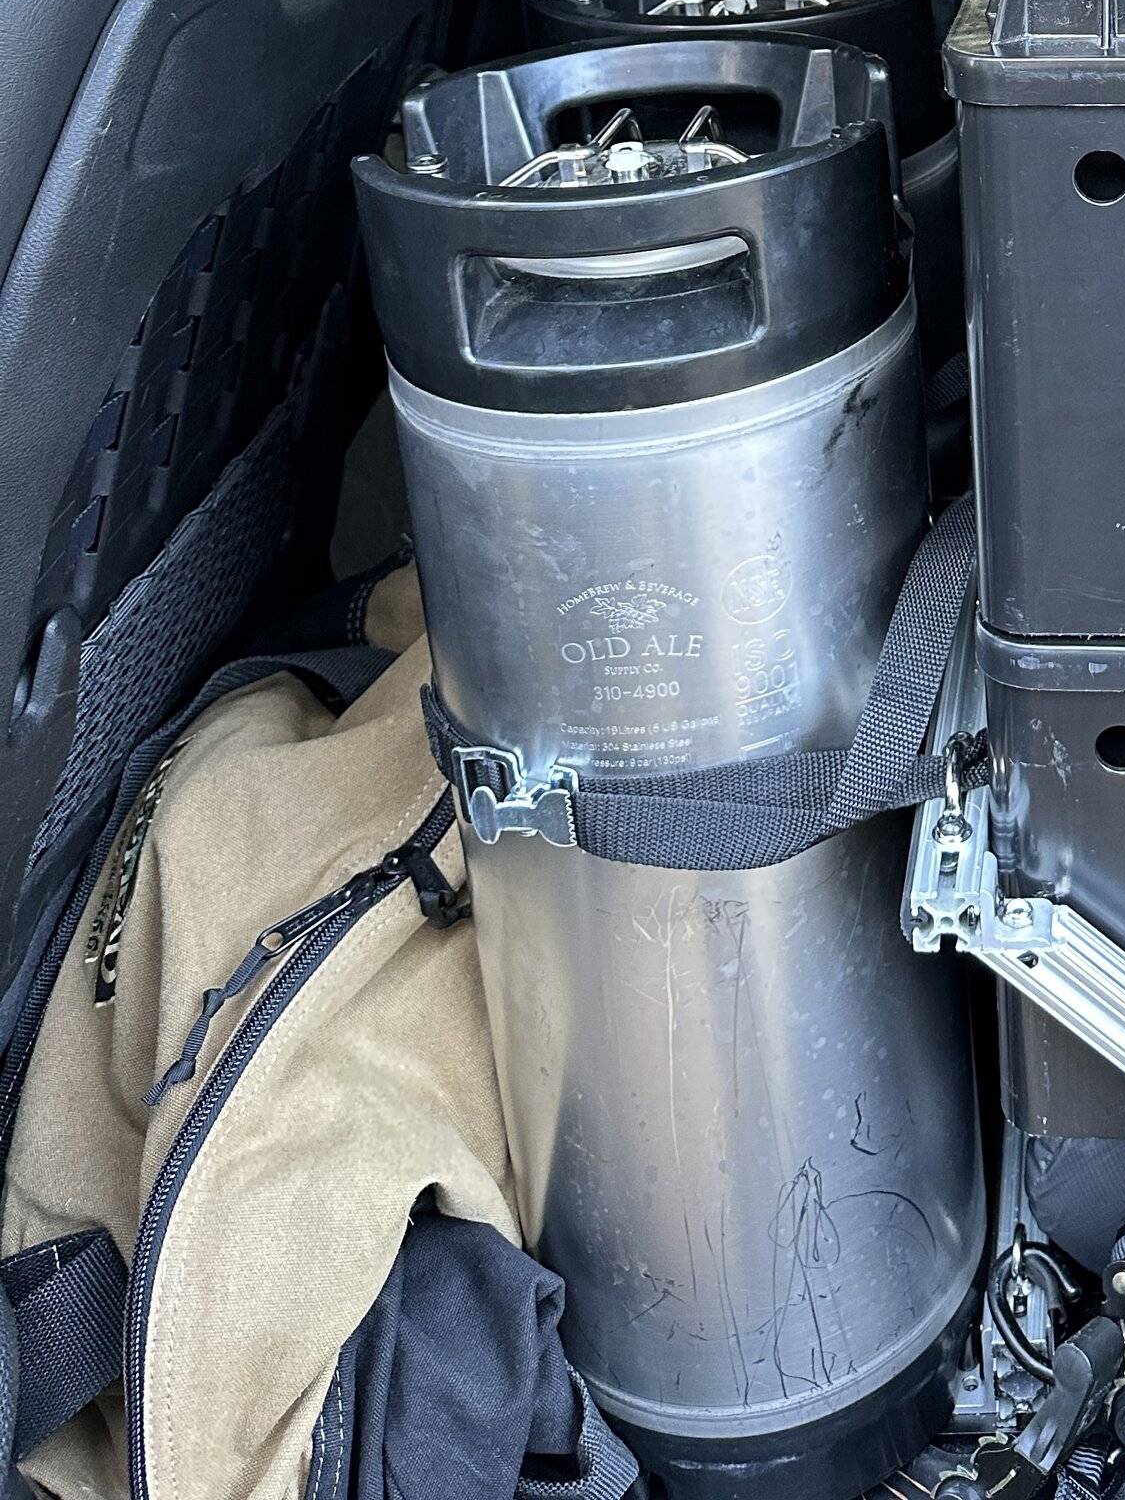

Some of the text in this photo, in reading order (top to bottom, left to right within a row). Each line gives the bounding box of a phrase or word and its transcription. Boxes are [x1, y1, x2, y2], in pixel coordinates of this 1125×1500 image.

[556, 580, 700, 615] HOMEBREW & BEVERAGE
[561, 634, 704, 664] OLD ALE
[604, 665, 641, 676] SUPPLY
[593, 681, 680, 701] 310-4900
